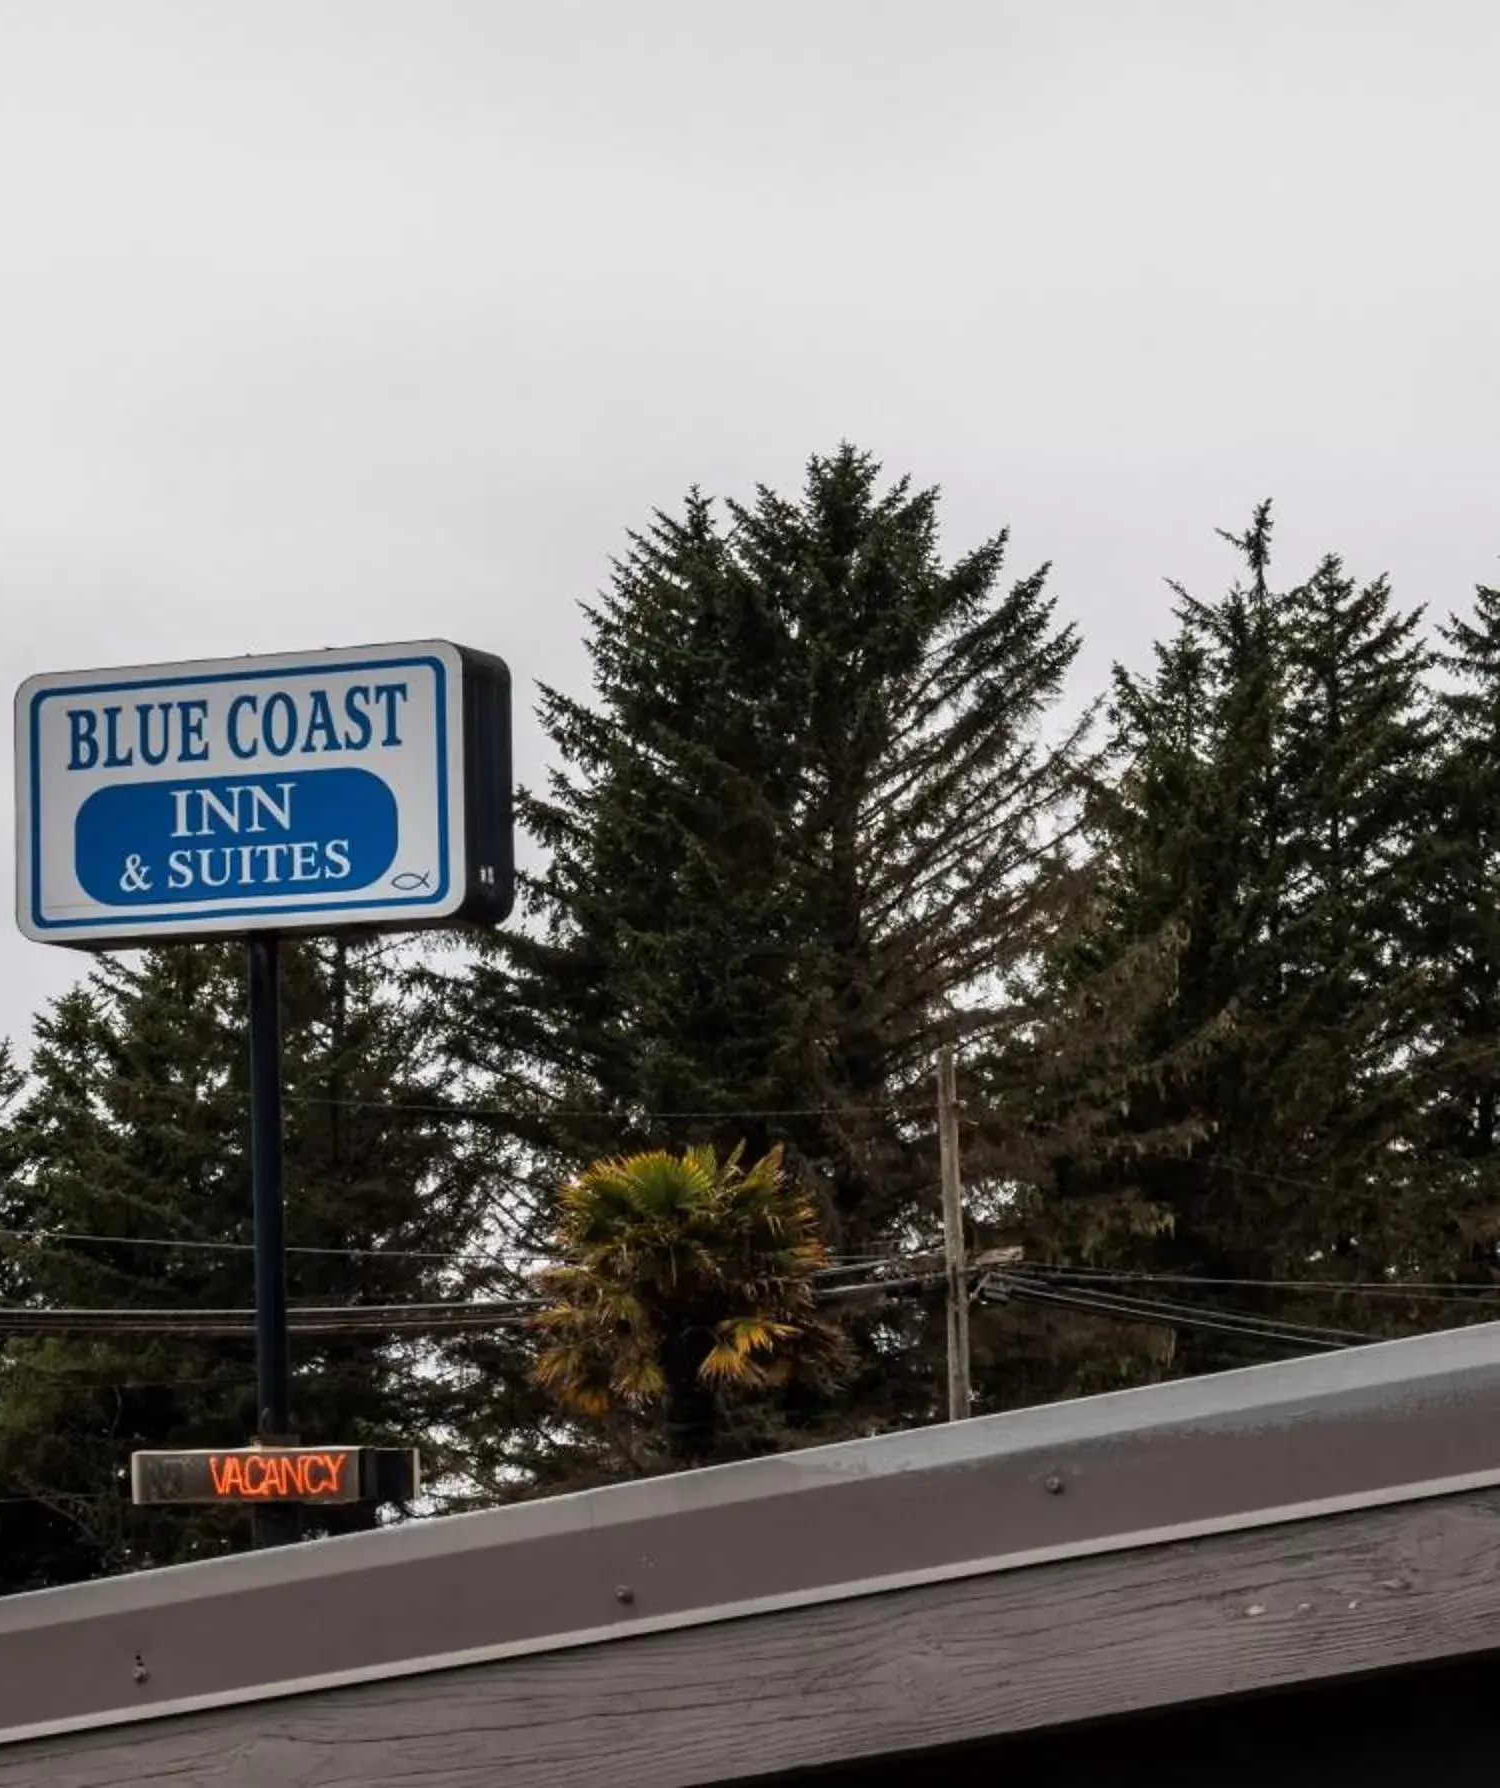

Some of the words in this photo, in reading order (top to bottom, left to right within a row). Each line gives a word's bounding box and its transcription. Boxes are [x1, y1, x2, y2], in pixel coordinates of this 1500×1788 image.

[67, 700, 209, 771] BLUE
[227, 683, 407, 759] COAST
[170, 783, 297, 838] INN
[119, 853, 154, 892] &
[168, 839, 352, 890] SUITES
[209, 1454, 346, 1496] VACANCY
